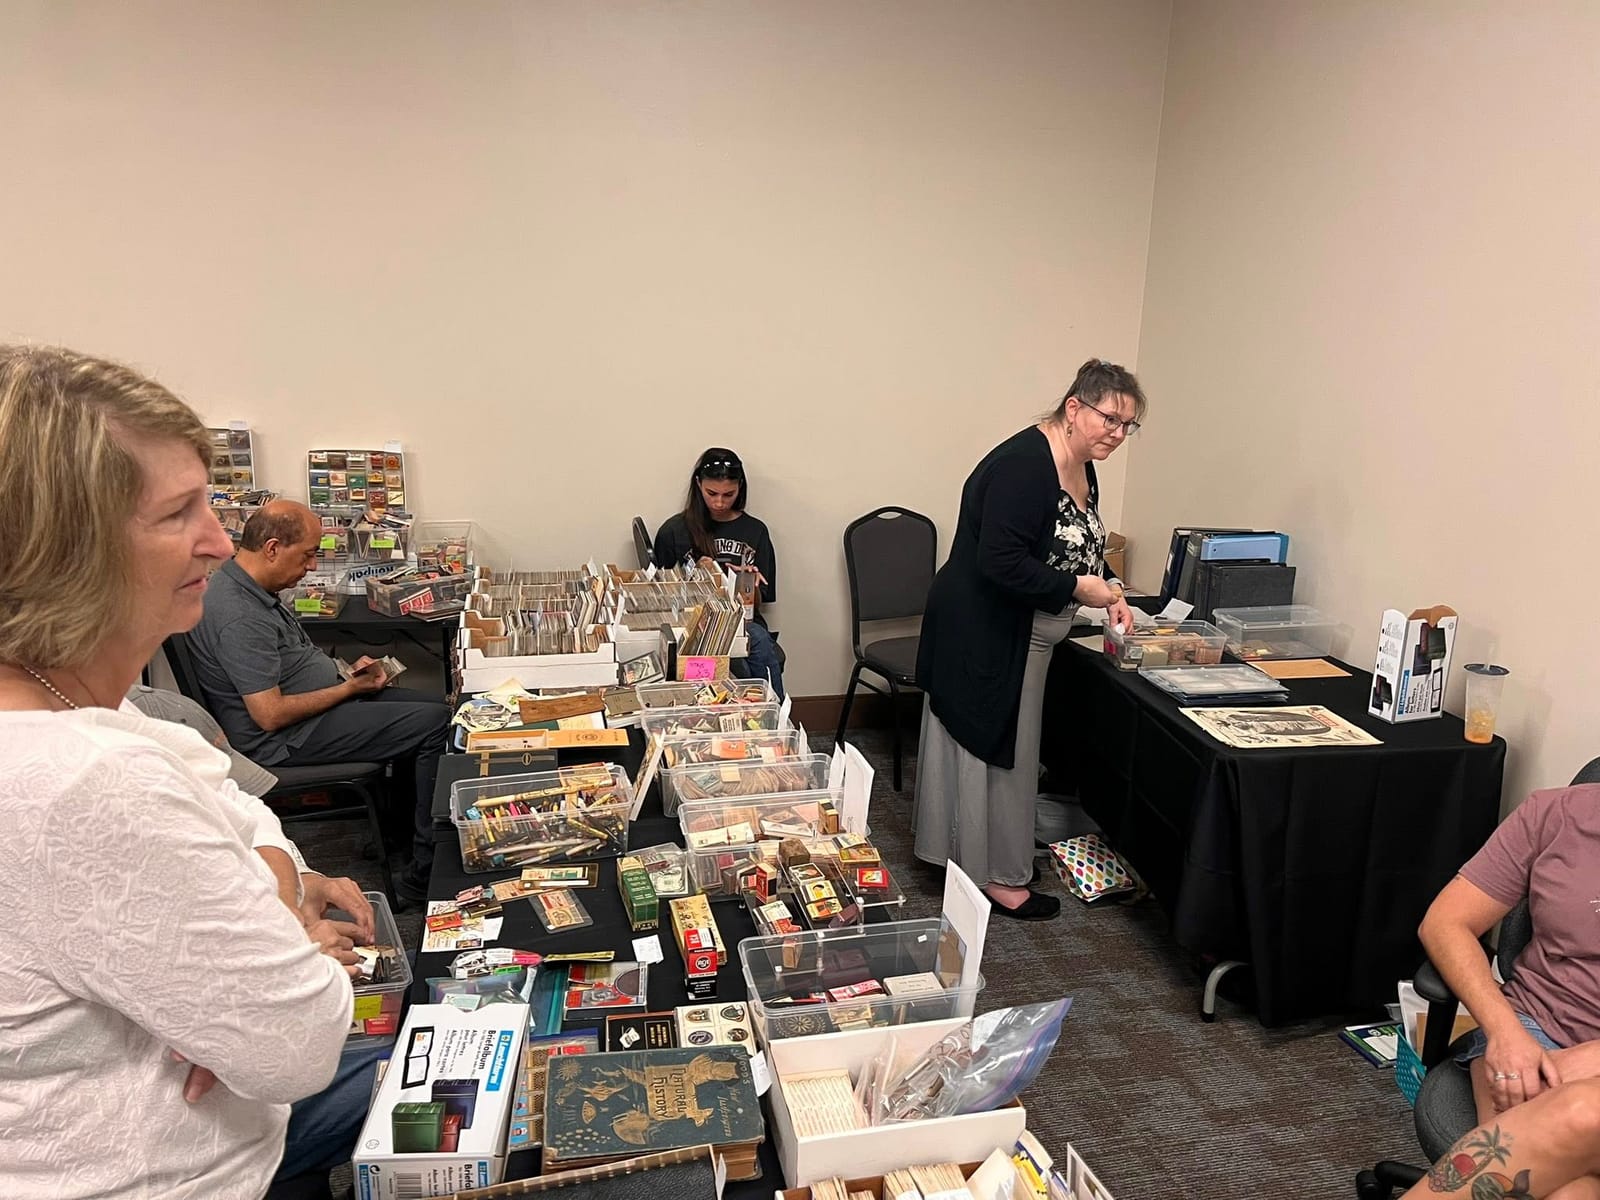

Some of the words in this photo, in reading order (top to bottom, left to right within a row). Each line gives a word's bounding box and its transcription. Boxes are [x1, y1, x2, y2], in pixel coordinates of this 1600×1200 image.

[479, 1030, 497, 1069] Briefalbum
[650, 1076, 673, 1119] HISTORY
[669, 1068, 687, 1113] NATURAL
